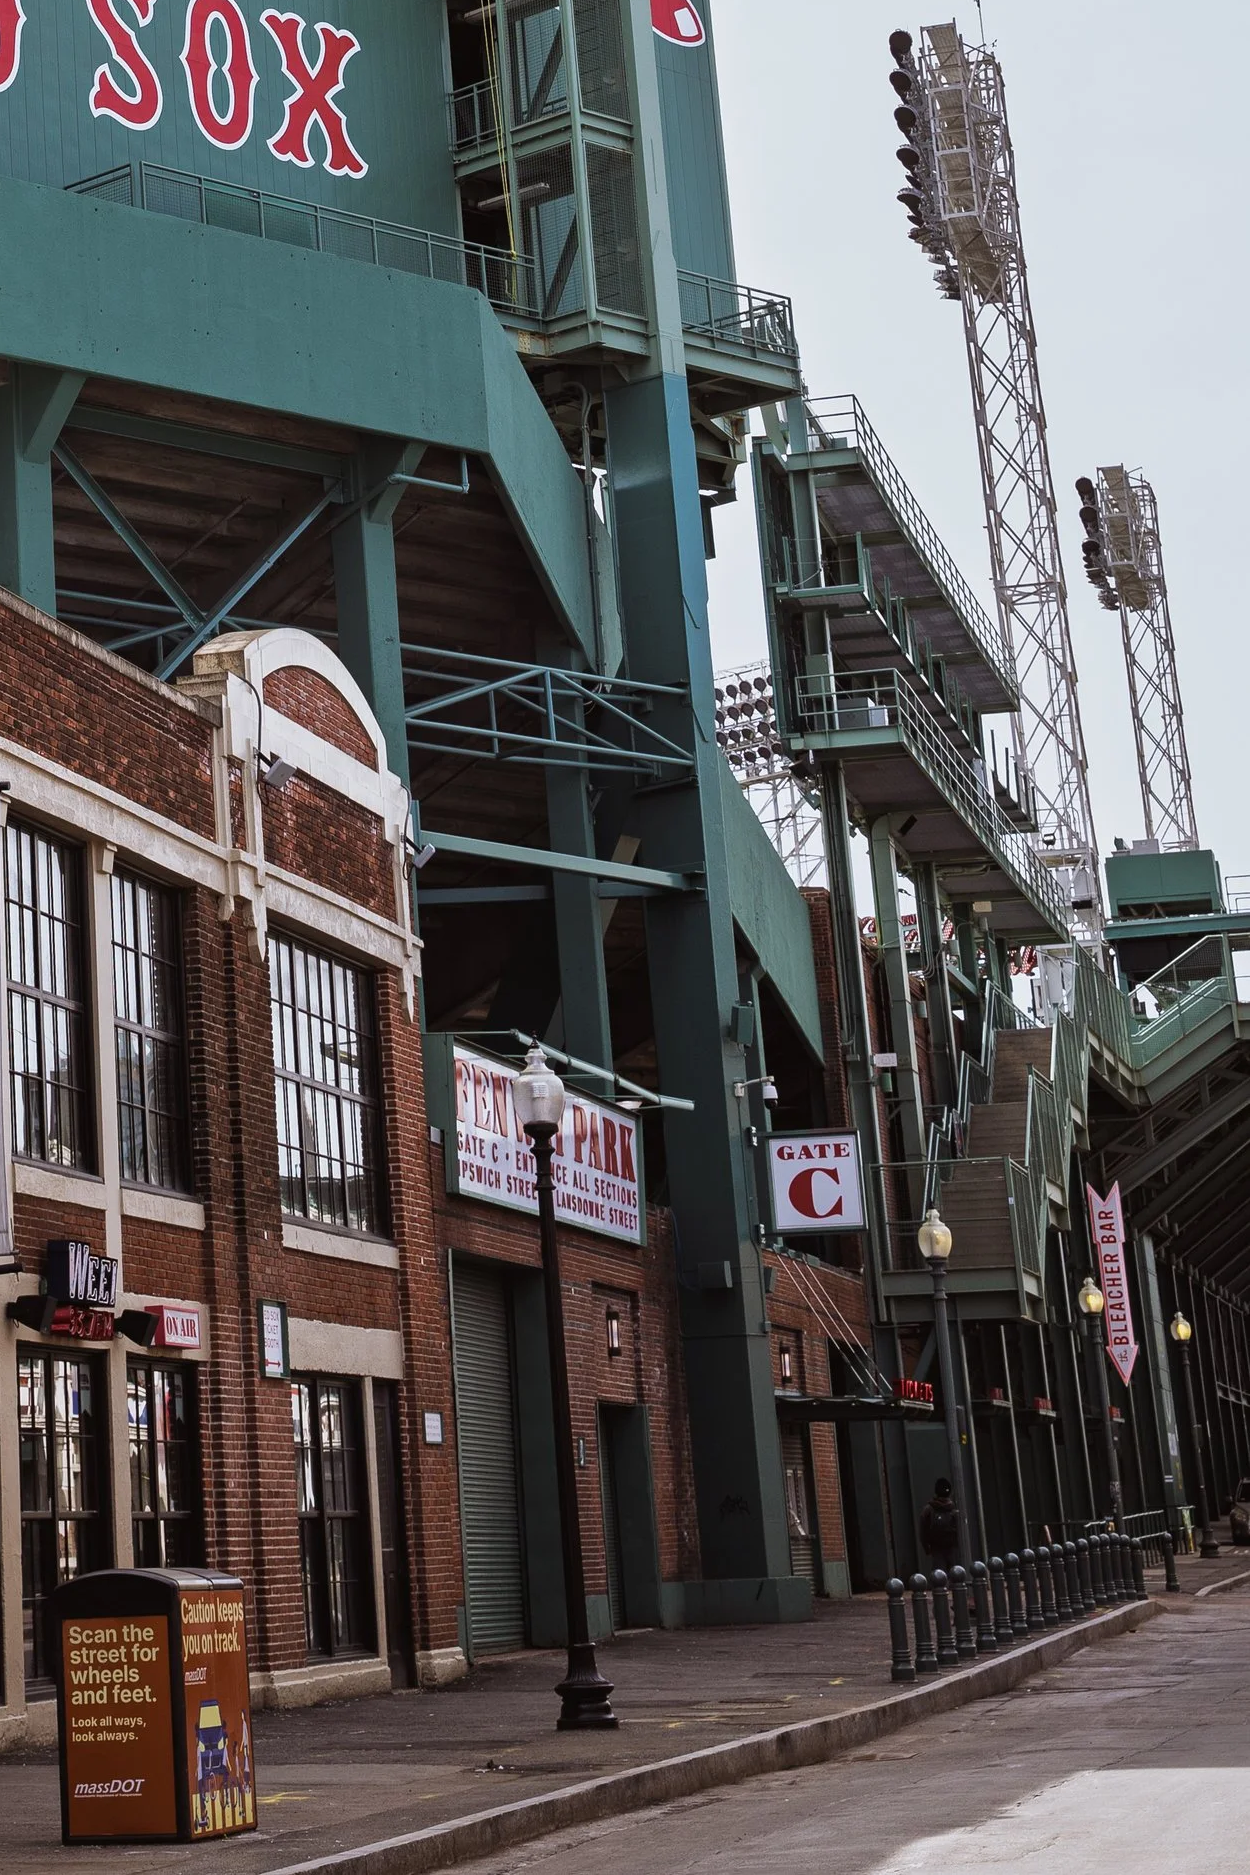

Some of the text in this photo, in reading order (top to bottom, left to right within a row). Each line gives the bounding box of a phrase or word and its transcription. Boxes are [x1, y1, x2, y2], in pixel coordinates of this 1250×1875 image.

[454, 1057, 636, 1183] FEN PARK
[776, 1143, 850, 1161] GATE
[457, 1130, 637, 1209] GATE C ENTNCE ALL SECTIONS
[506, 1174, 538, 1200] STREE
[556, 1190, 605, 1221] LANSDOWNE
[609, 1206, 638, 1231] STREET
[788, 1167, 843, 1219] C
[1098, 1210, 1117, 1244] BAR
[69, 1242, 118, 1305] WEEI
[1103, 1253, 1129, 1346] BLEACHER
[166, 1316, 197, 1338] ON AIR
[181, 1597, 244, 1628] Caution keeps
[69, 1624, 154, 1644] Scan the
[182, 1627, 241, 1662] you on track.
[70, 1643, 160, 1664] street for
[70, 1665, 140, 1685] wheels
[71, 1685, 157, 1705] and feet.
[72, 1716, 147, 1728] Look all ways,
[72, 1731, 139, 1743] look always.
[74, 1779, 145, 1794] massDOT
